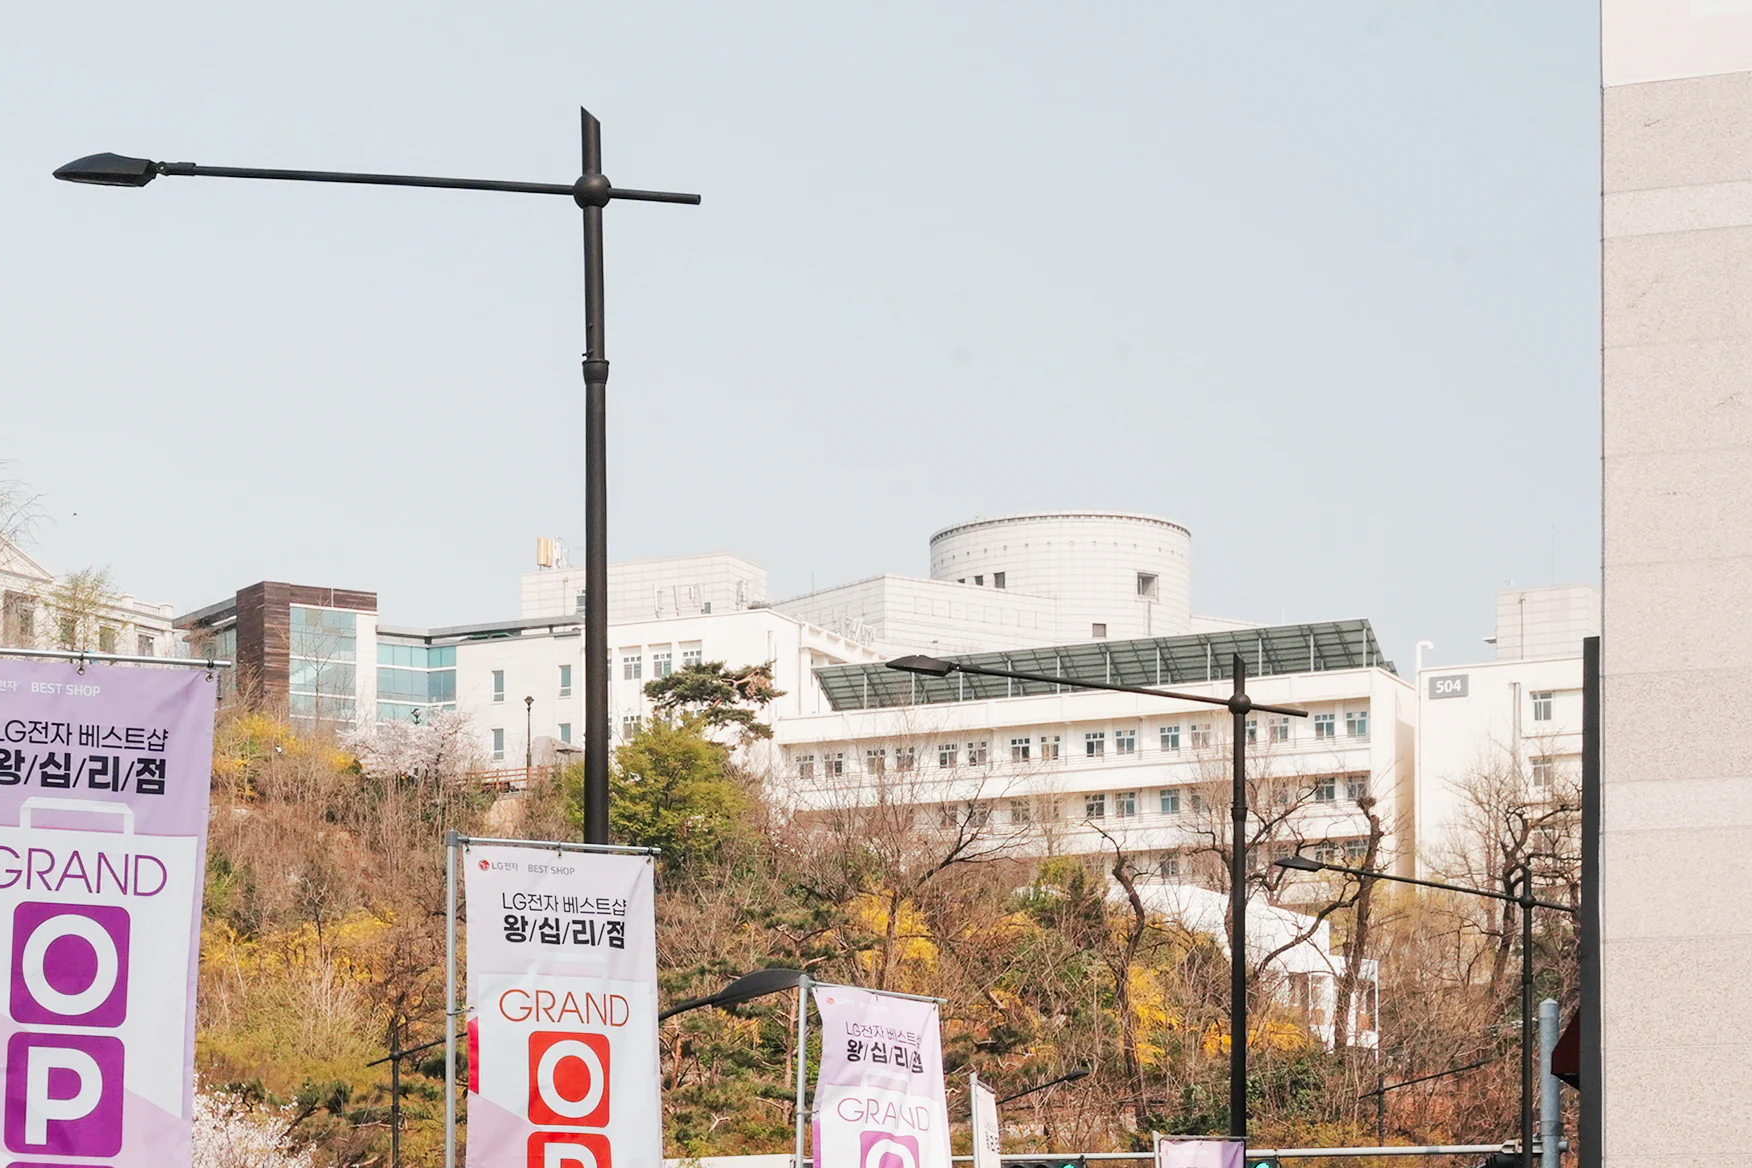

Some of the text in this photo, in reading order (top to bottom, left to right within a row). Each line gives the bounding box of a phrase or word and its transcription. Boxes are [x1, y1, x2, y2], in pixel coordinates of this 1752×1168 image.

[31, 682, 62, 695] BEST
[66, 684, 101, 697] SHOP
[1435, 679, 1462, 693] 504
[79, 724, 169, 752] 베스트샵
[528, 864, 549, 874] BEST
[551, 866, 575, 876] SHOP
[502, 892, 627, 917] LG전자 베스트샵
[503, 914, 625, 949] 왕/십/리/점
[499, 988, 630, 1027] GRAND
[845, 1021, 885, 1039] LG전자
[837, 1098, 930, 1132] GRAND
